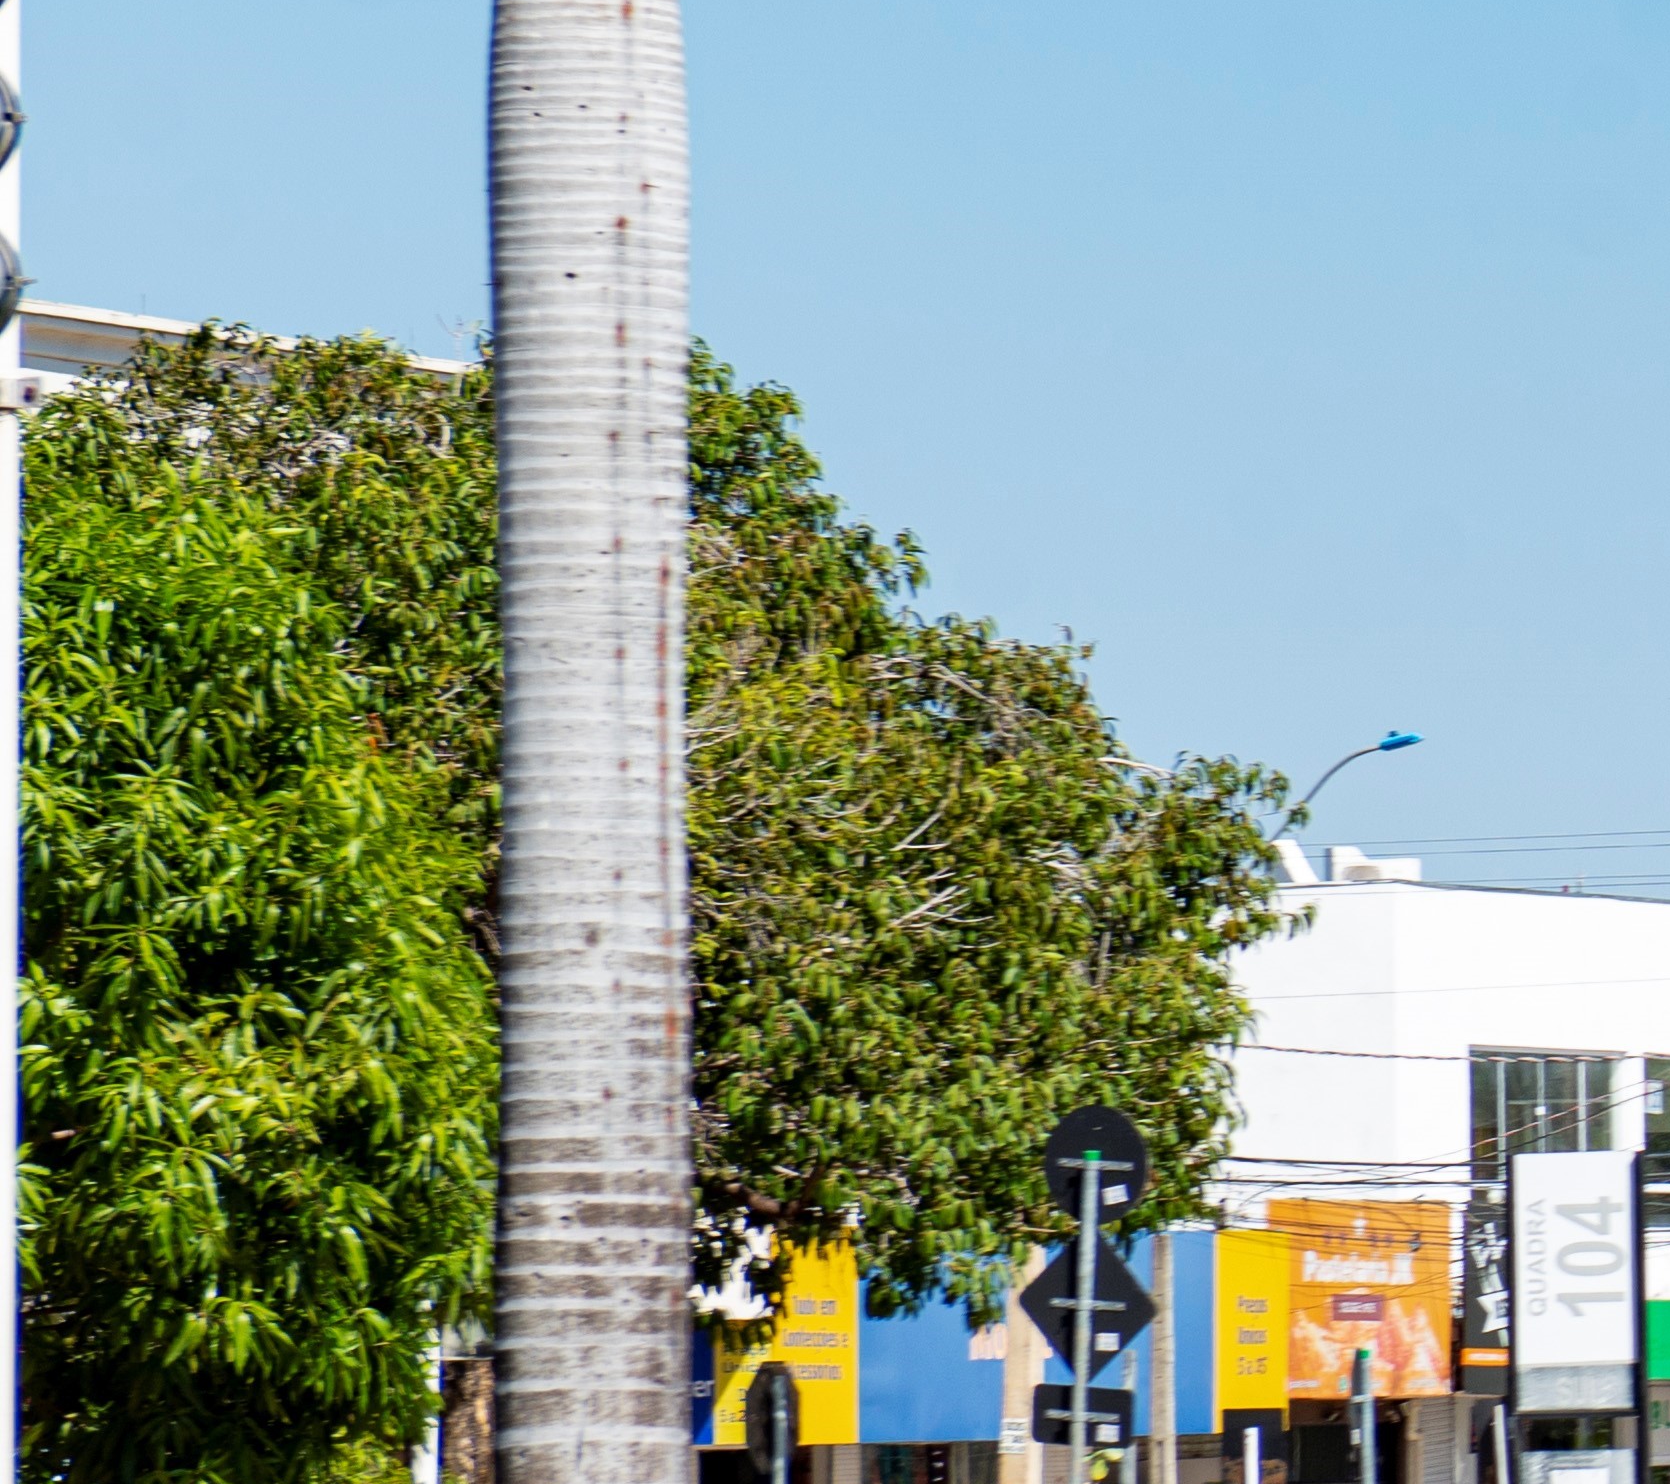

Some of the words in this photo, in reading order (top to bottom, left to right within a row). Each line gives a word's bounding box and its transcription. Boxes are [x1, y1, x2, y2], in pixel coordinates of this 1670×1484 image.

[1527, 1198, 1547, 1317] QUADRA
[1555, 1196, 1625, 1317] 104
[787, 1359, 842, 1380] cessórios
